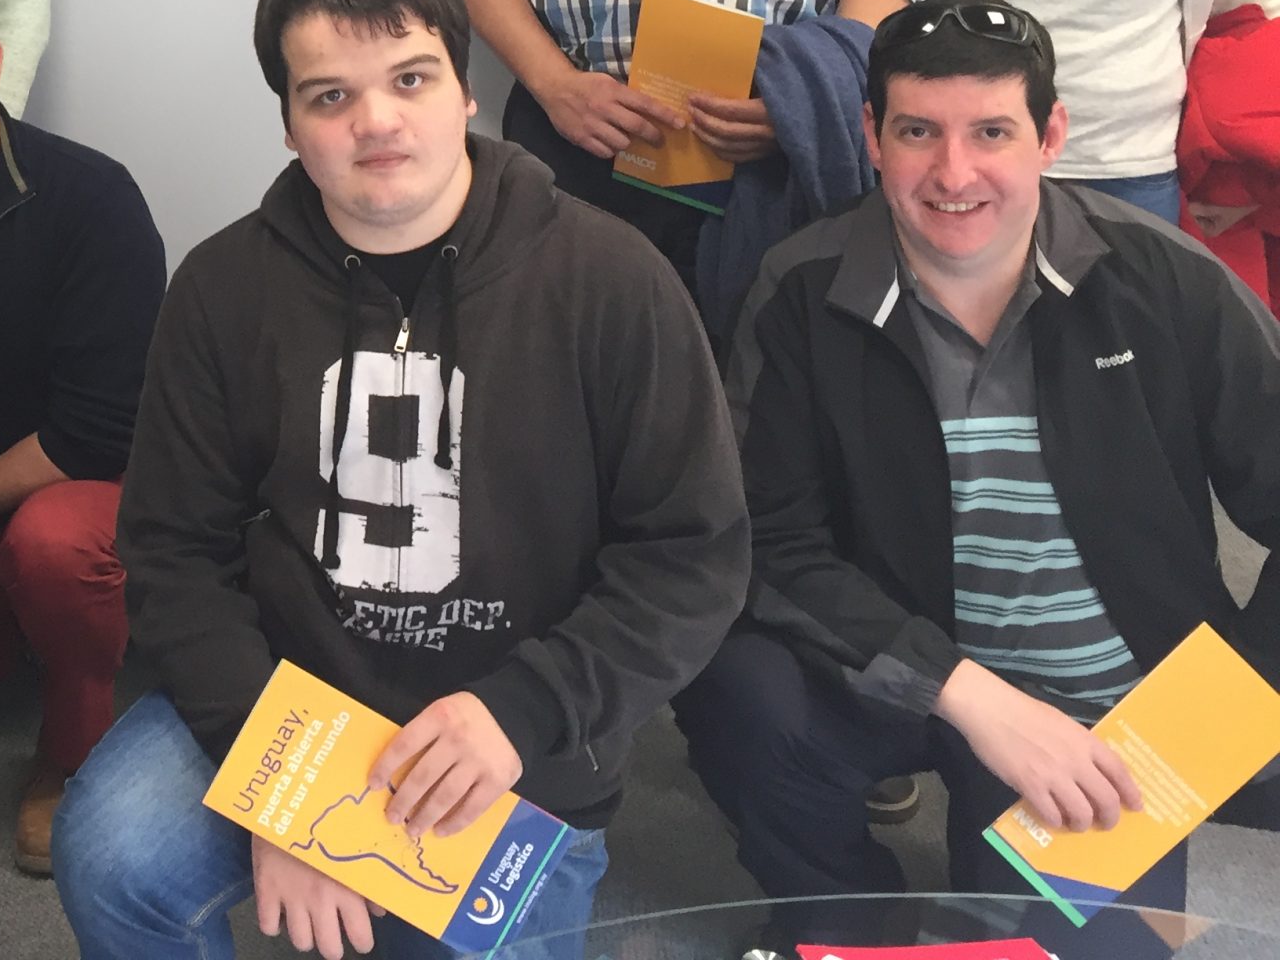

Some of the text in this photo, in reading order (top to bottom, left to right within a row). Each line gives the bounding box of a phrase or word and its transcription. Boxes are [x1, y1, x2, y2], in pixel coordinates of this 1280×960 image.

[1095, 349, 1135, 369] Reebok
[314, 351, 465, 594] 9
[437, 599, 511, 631] DEP.
[233, 709, 309, 812] Uruguay,
[257, 719, 324, 828] puerta abierta
[273, 711, 350, 836] del sur al mundo
[488, 841, 520, 884] Uruguay
